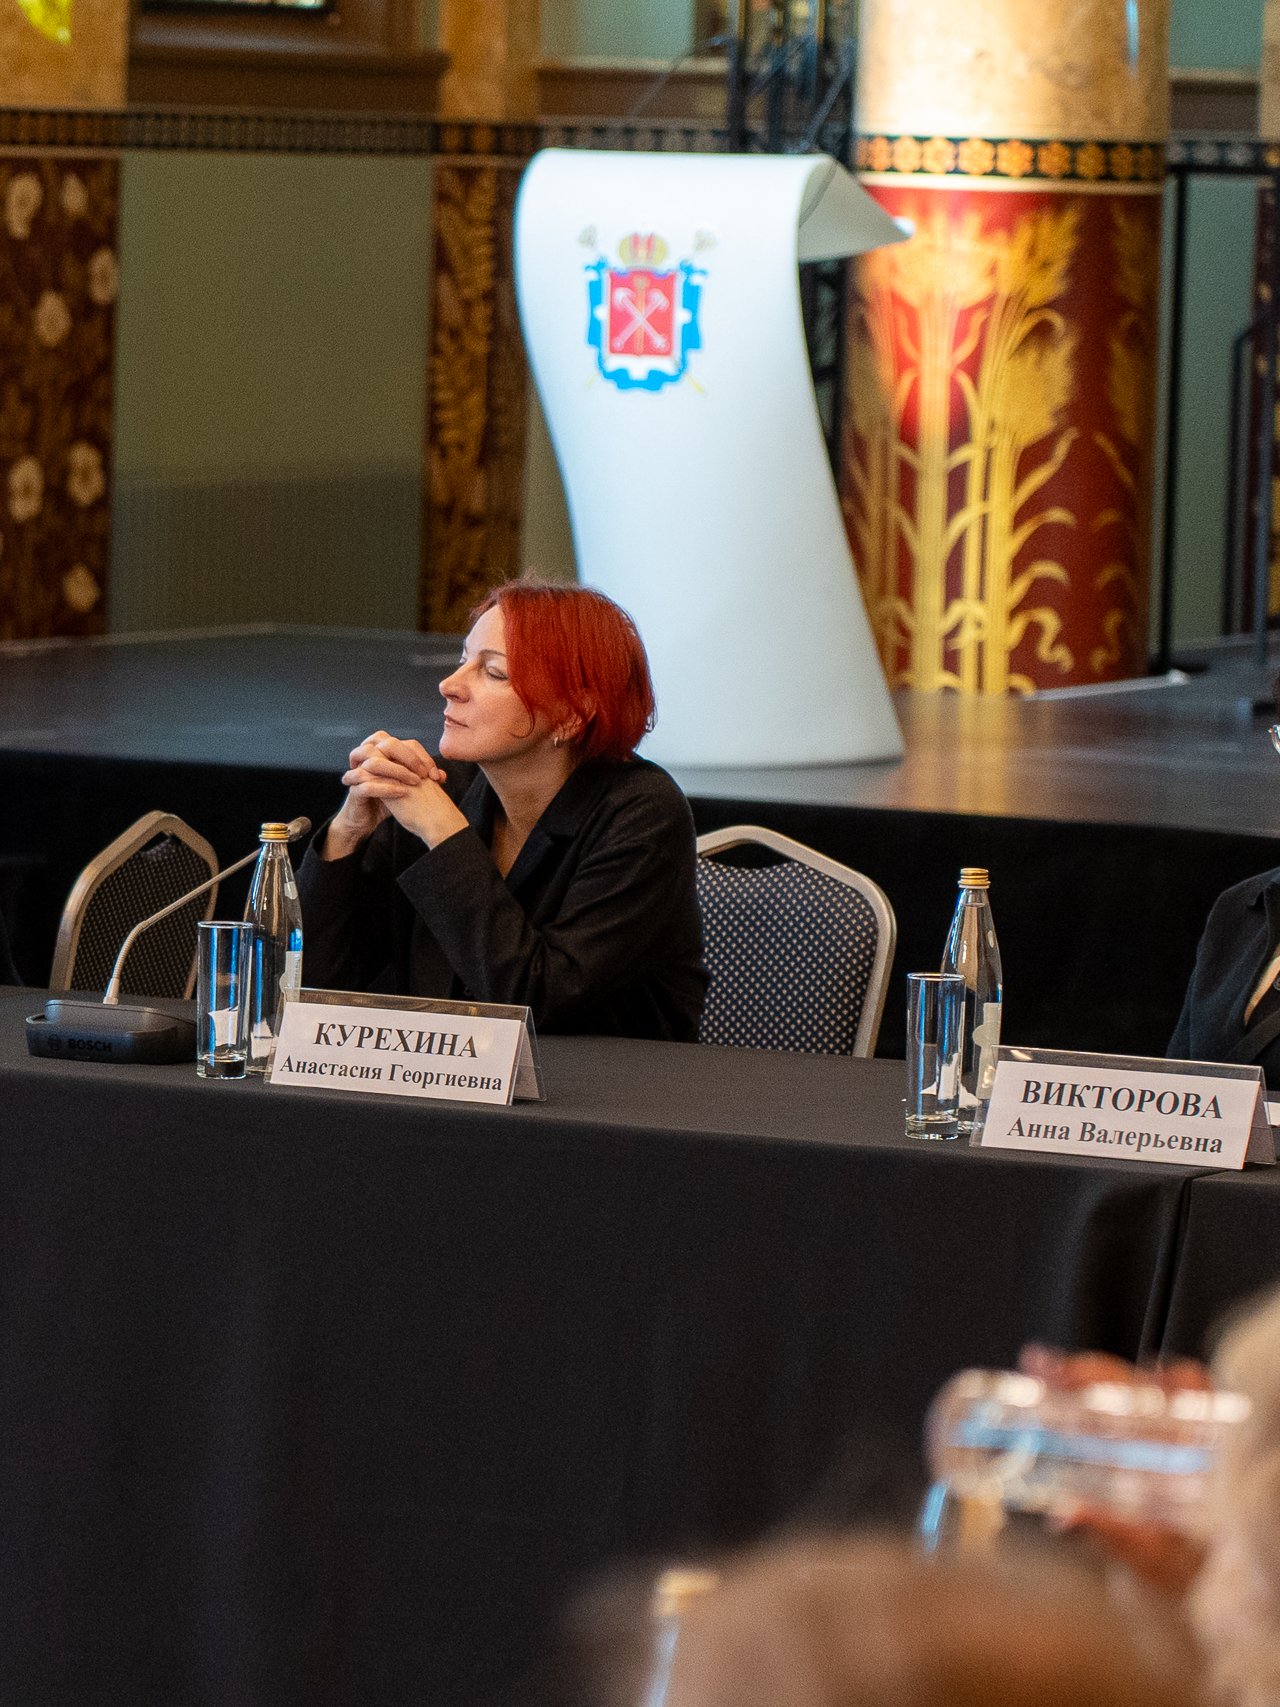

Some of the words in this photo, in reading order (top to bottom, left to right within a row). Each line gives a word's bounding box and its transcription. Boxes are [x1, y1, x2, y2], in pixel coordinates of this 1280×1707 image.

[67, 1038, 112, 1052] BOSCH
[314, 1022, 479, 1059] КУРЕХИНА
[279, 1055, 382, 1081] Анастасия
[388, 1063, 503, 1091] Георгиевна
[1020, 1079, 1223, 1119] ВИКТОРОВА
[1007, 1117, 1070, 1140] Анна
[1079, 1121, 1223, 1153] Валерьевна
